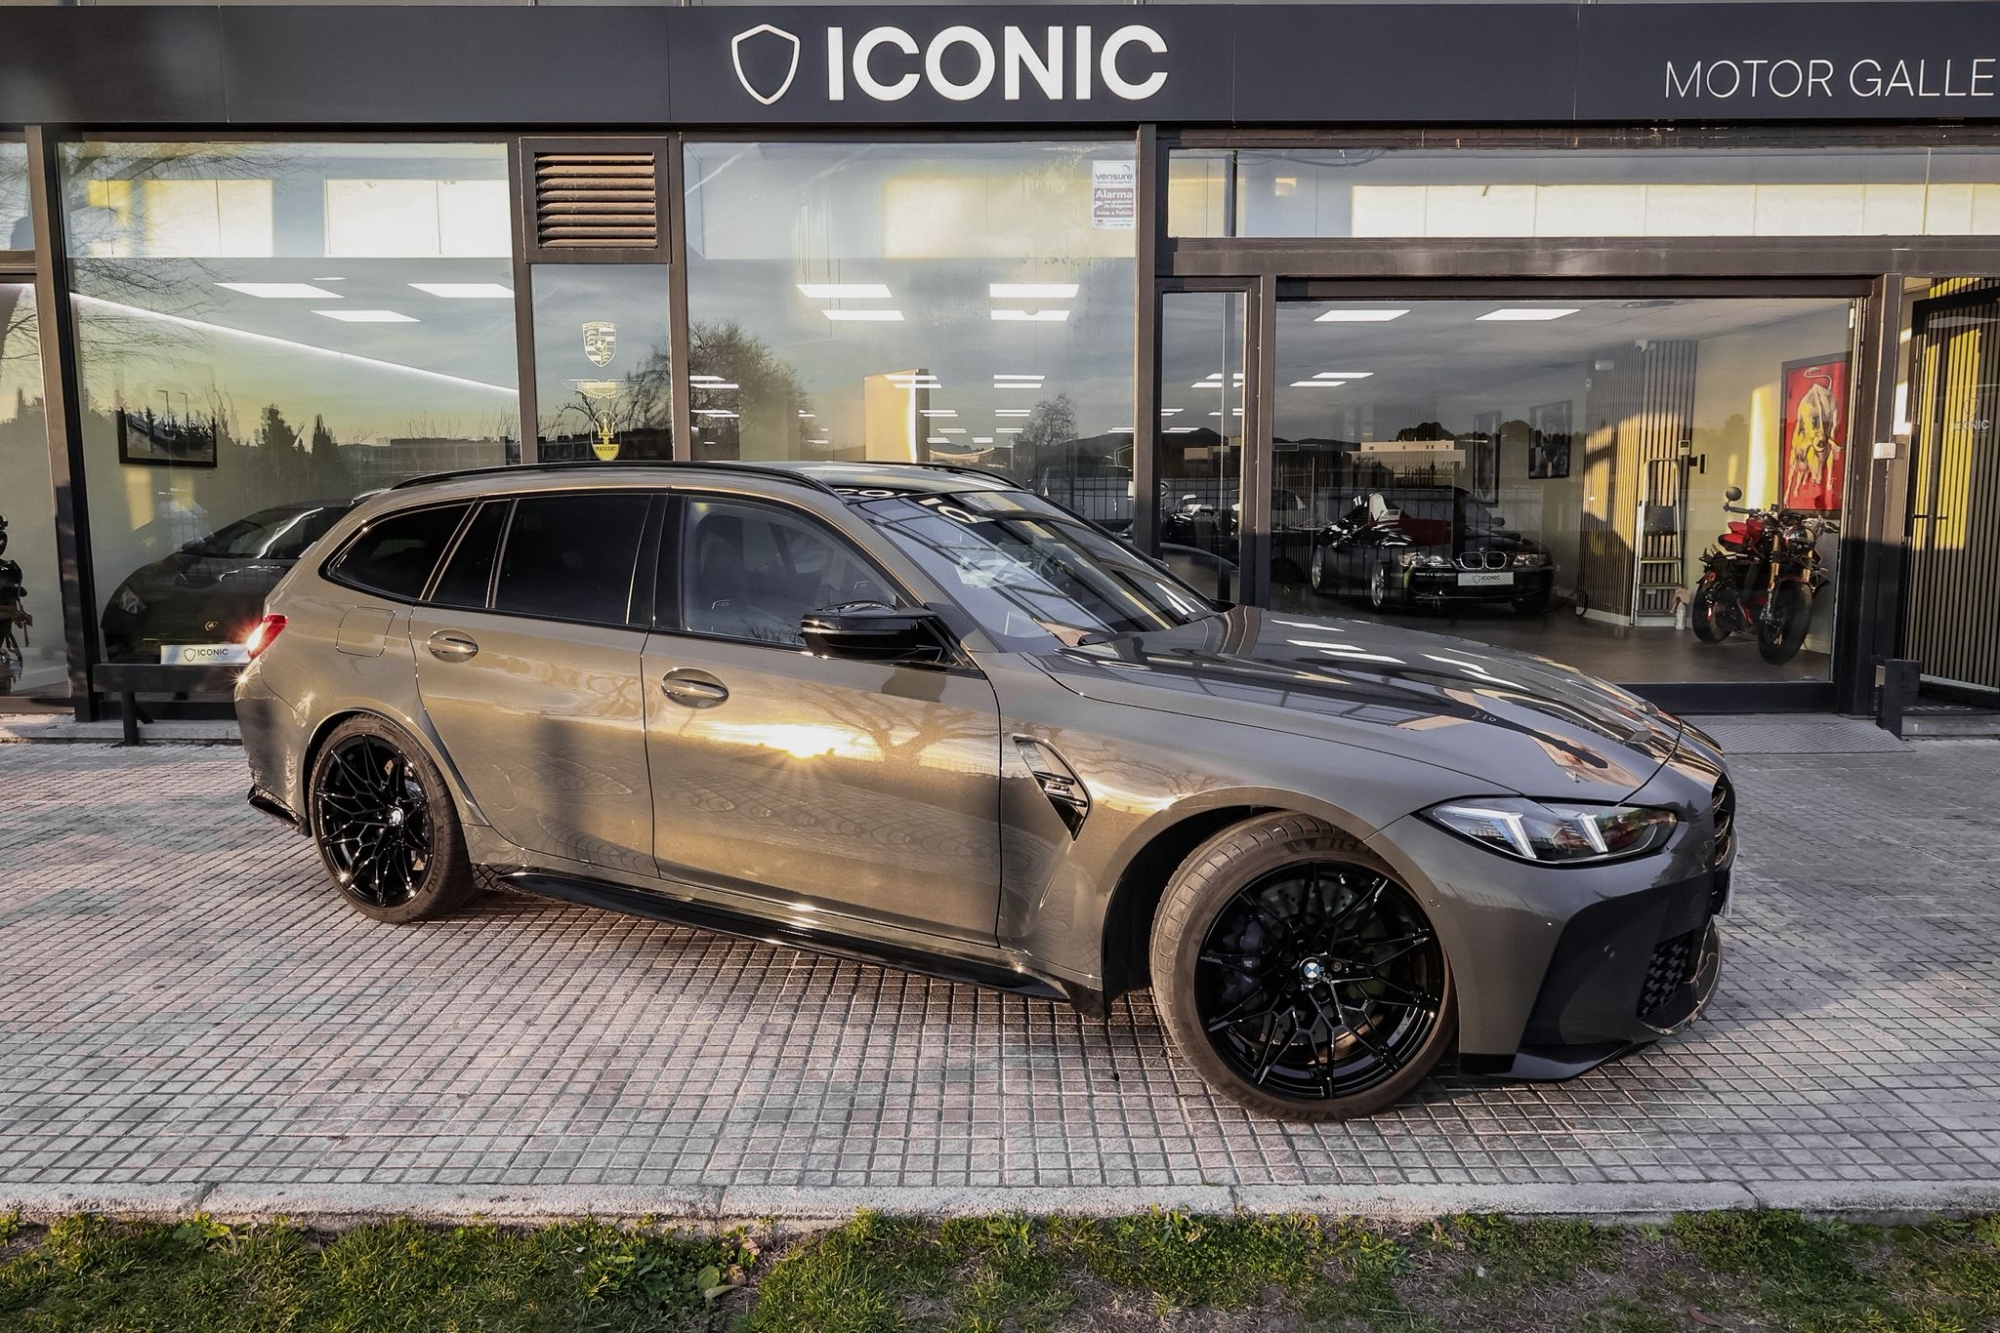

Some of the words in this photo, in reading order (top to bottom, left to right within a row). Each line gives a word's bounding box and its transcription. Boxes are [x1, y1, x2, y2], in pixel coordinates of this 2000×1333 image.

[827, 25, 1169, 101] ICONIC
[1665, 59, 1834, 98] MOTOR
[1849, 58, 1997, 97] GALLE
[1095, 190, 1133, 199] Alarma
[197, 648, 229, 656] ICONIC
